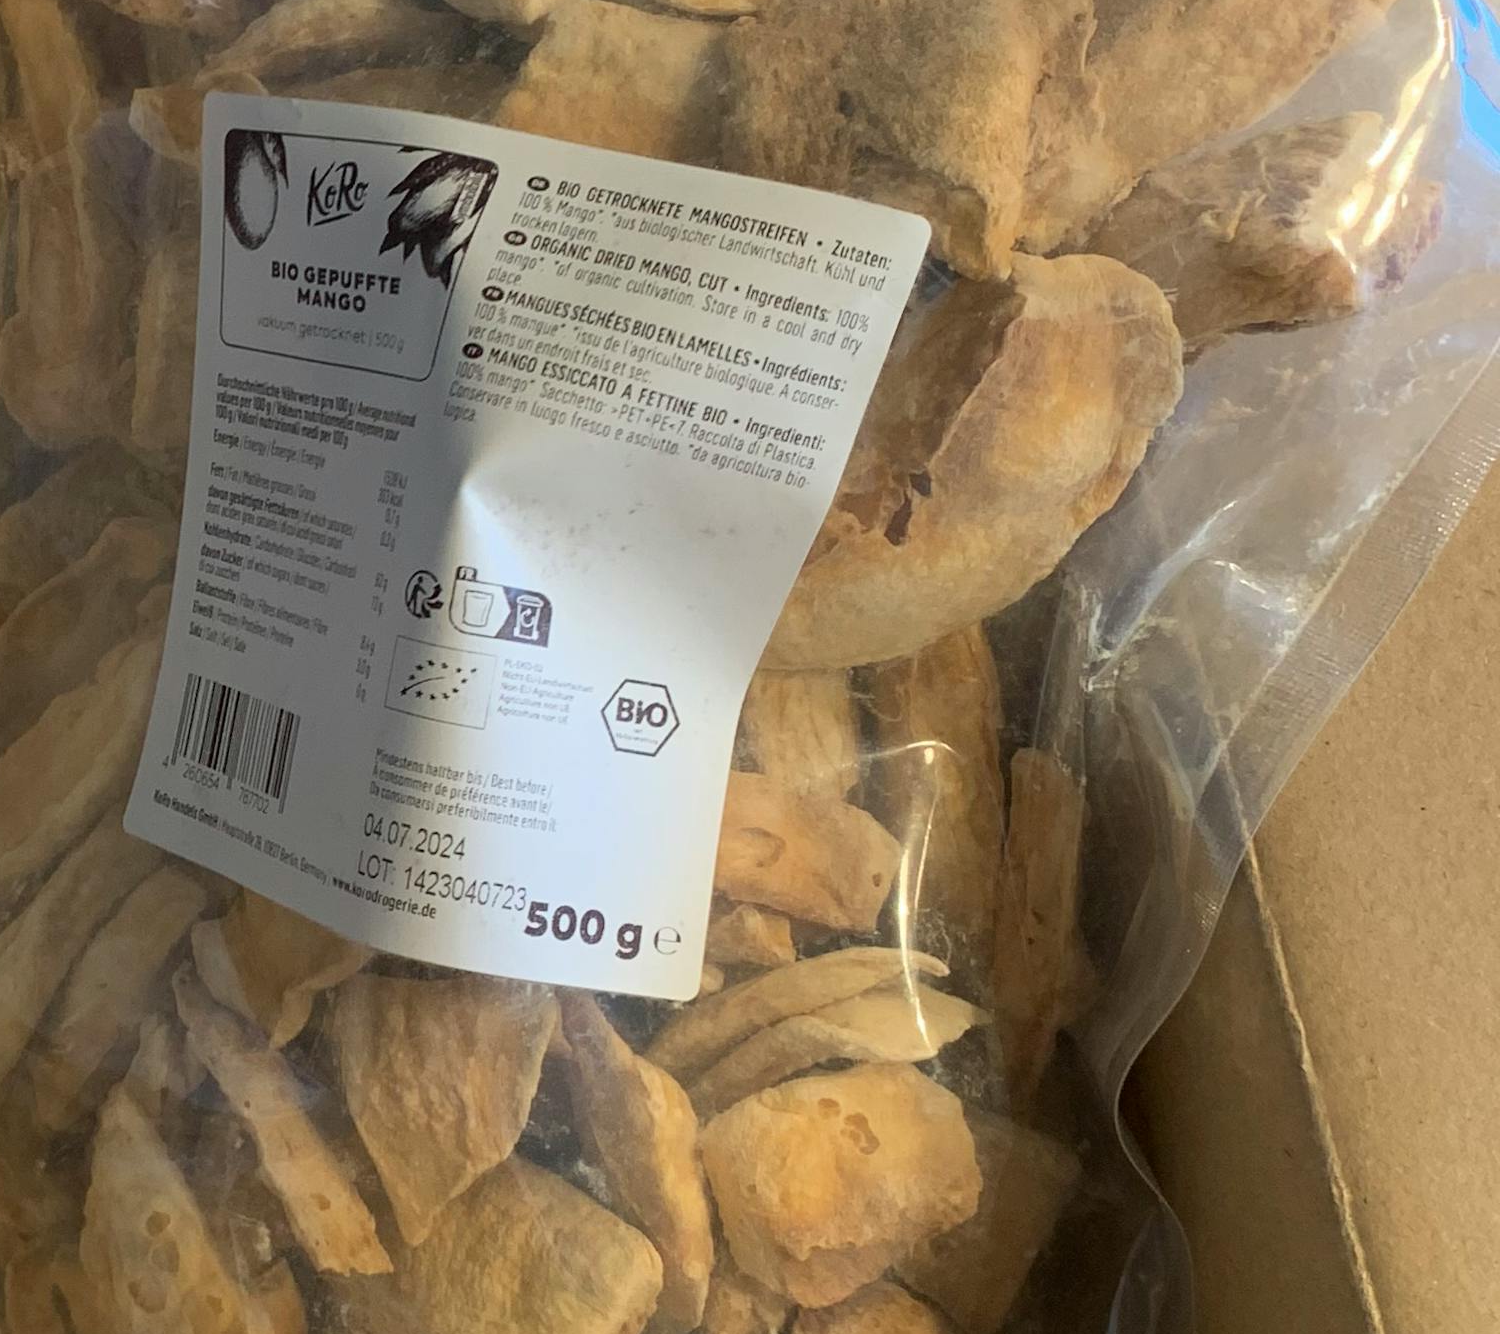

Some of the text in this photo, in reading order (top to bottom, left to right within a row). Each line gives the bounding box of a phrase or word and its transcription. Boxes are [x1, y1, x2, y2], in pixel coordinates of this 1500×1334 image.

[307, 162, 369, 226] KoRo
[511, 212, 558, 233] trocken
[556, 181, 891, 270] BIO GETROCKNETE MANGOSTREIFEN Zutaten:
[638, 218, 716, 246] biologischer
[825, 261, 856, 283] Kühl
[859, 274, 886, 291] und
[272, 261, 401, 295] BIO GEPUFFTE
[297, 287, 366, 312] MANGO
[531, 235, 591, 261] ORGANIC
[594, 249, 636, 270] DRIED
[698, 272, 728, 292] CUT
[745, 285, 830, 322] Ingredients:
[505, 290, 846, 392] MANGUES SÉCHÉES BIO EN LAMELLES Ingrédients:
[574, 268, 622, 289] organic
[701, 296, 738, 319] Store
[743, 306, 757, 324] in
[762, 315, 771, 328] a
[776, 319, 806, 338] cool
[810, 329, 836, 346] and
[840, 334, 862, 356] dry
[487, 328, 627, 376] dans endroit frais et
[603, 335, 620, 352] de
[622, 339, 703, 376] l'agriculture
[487, 348, 825, 451] MANGO ESSICCATO A FETTINE BIO Ingredienti:
[688, 423, 745, 451] Raccolta
[747, 439, 762, 455] di
[364, 813, 465, 860] 04.07.2024
[333, 877, 436, 919] www.korodrogerie.de
[358, 851, 526, 911] LOT: 1423040723
[524, 901, 642, 960] 500 g
